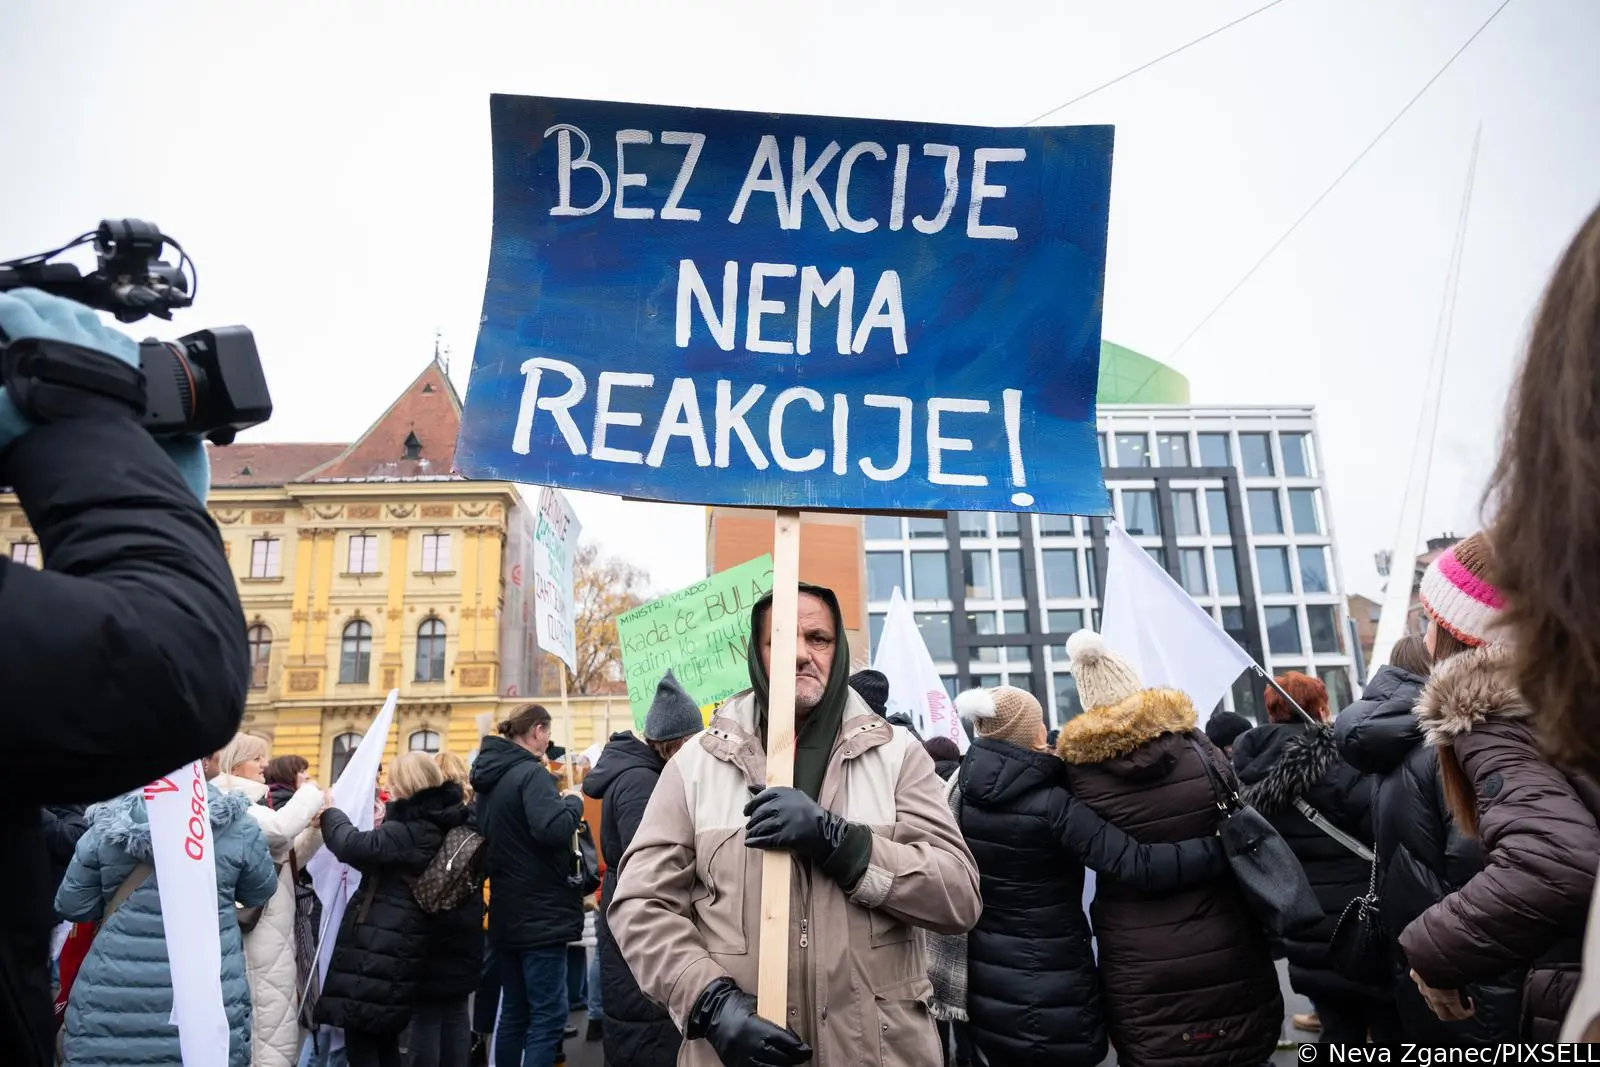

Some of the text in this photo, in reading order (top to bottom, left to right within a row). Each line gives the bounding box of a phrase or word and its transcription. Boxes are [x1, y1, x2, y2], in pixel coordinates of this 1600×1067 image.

[544, 123, 1027, 240] BEZ AKCIJE
[675, 259, 908, 355] NEMA
[511, 357, 1035, 507] REAKCIJE!
[621, 619, 672, 656] kada
[674, 608, 697, 636] će
